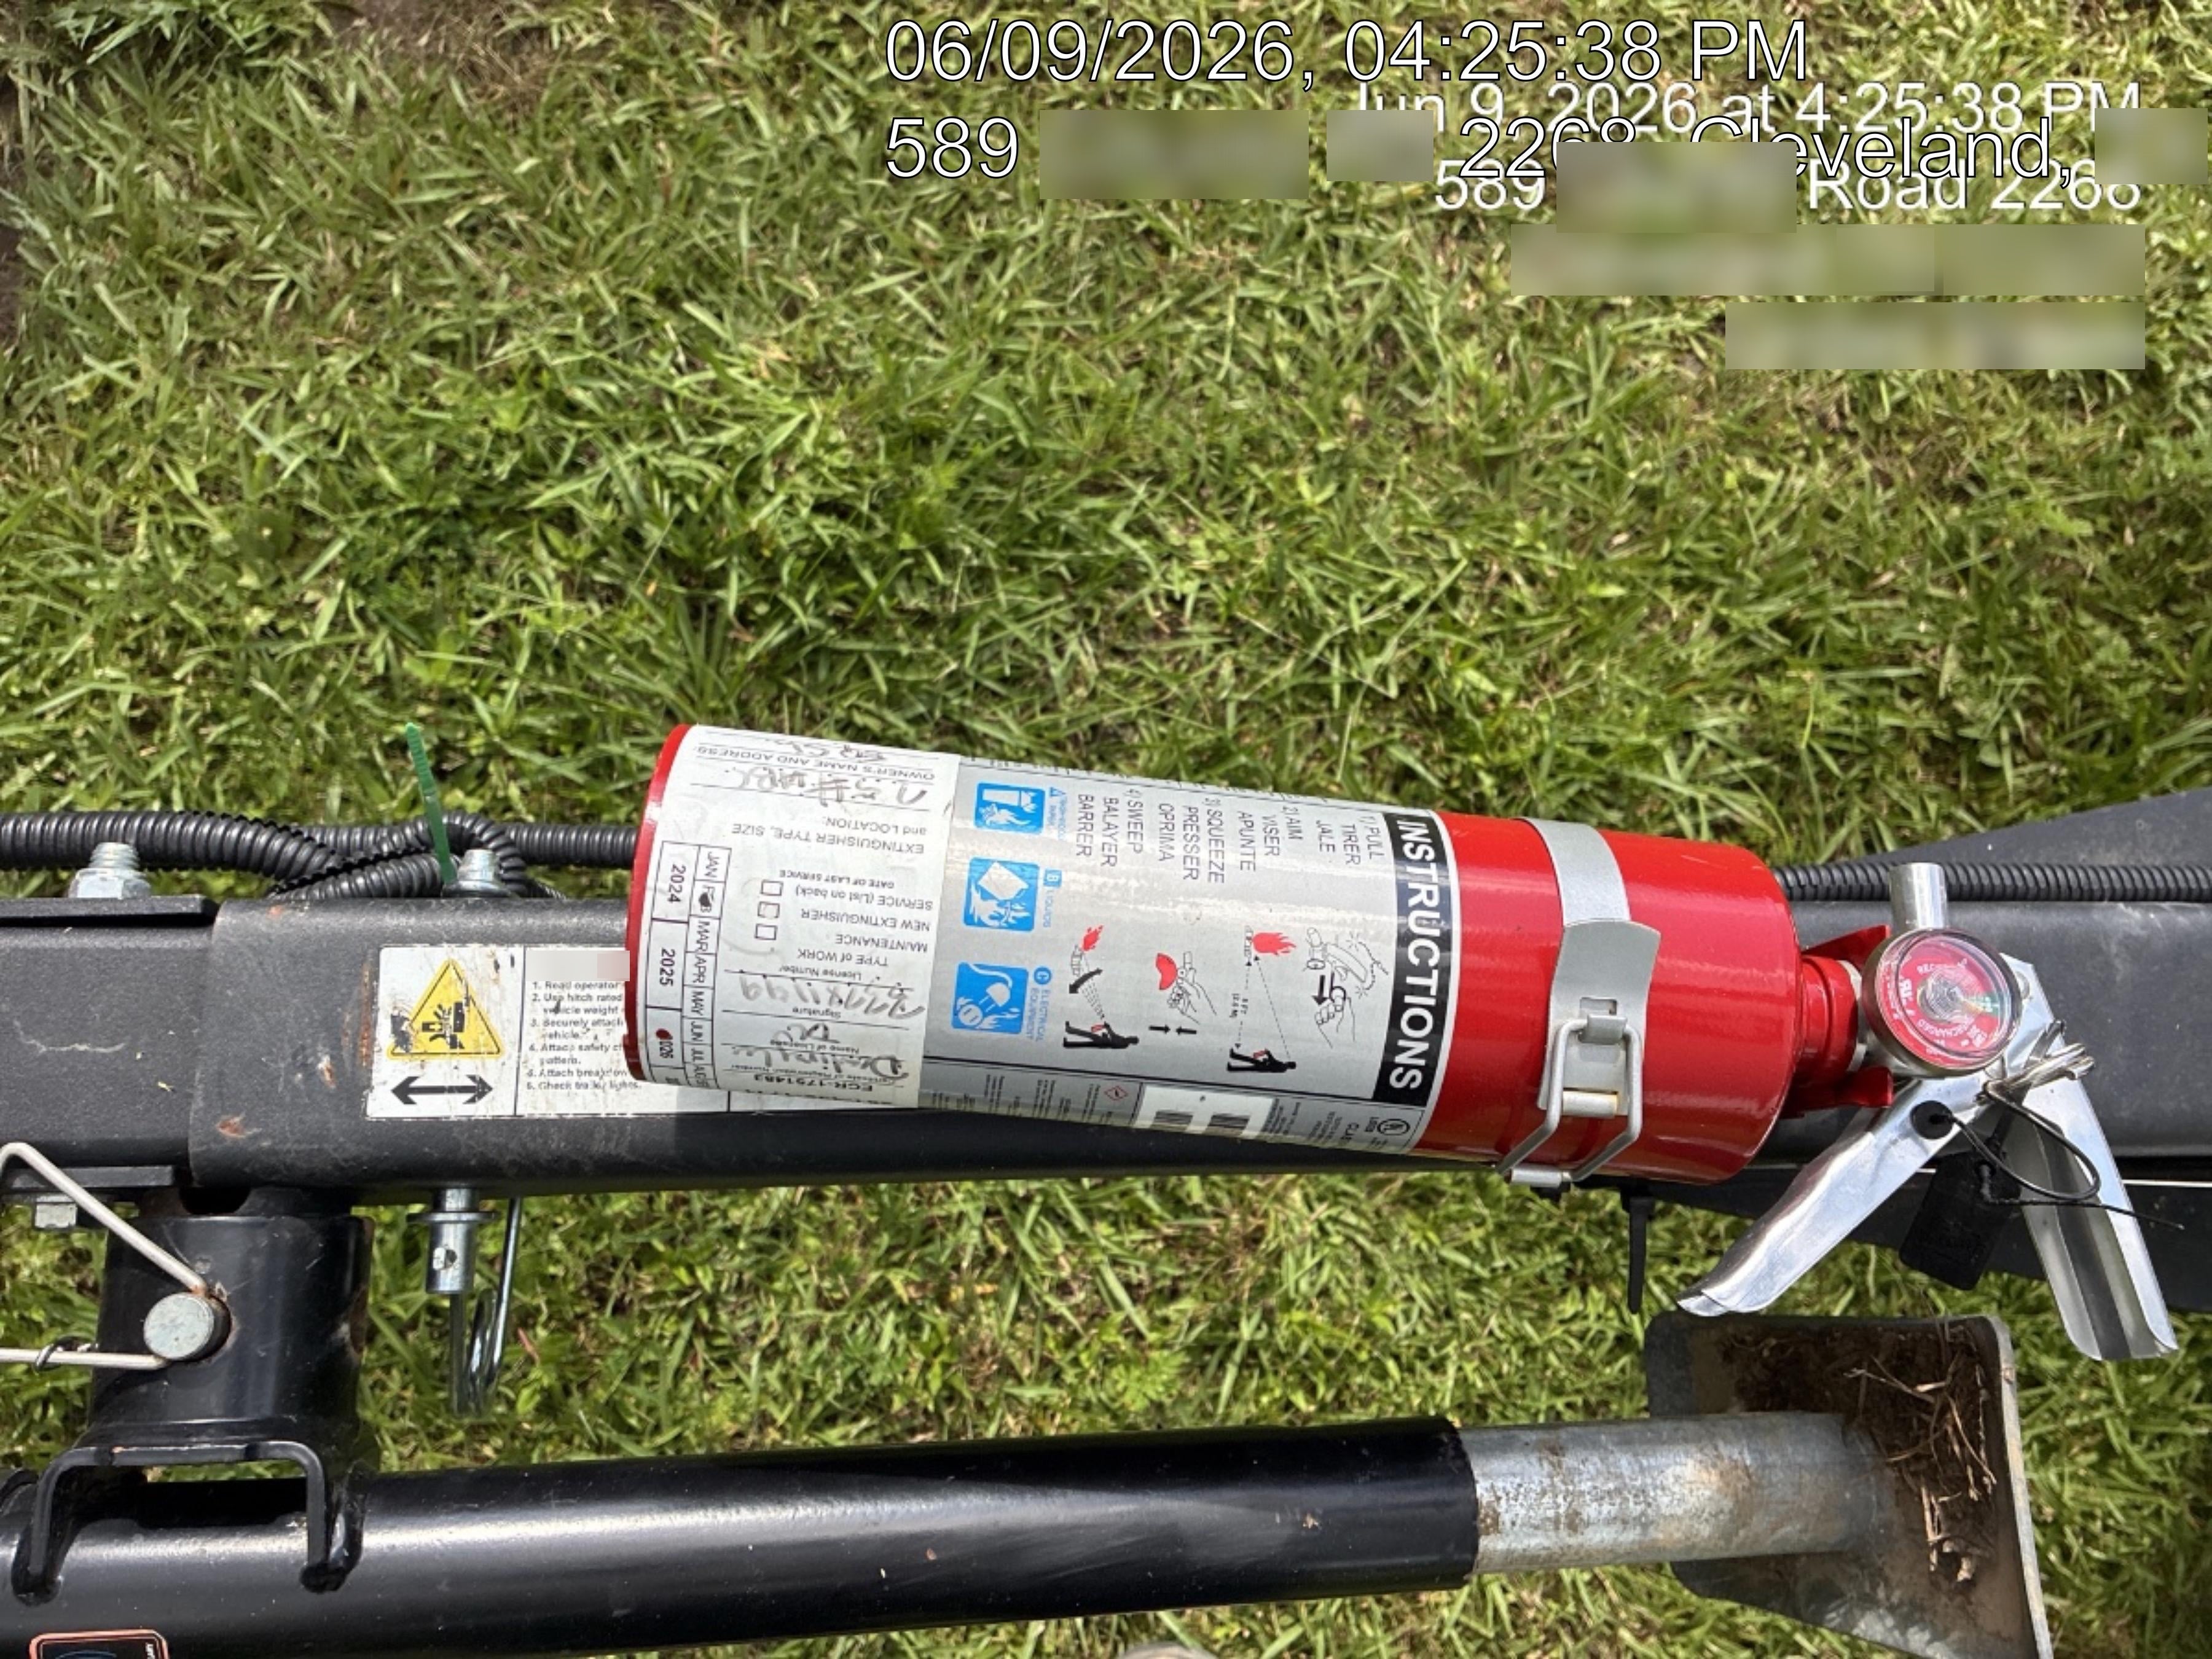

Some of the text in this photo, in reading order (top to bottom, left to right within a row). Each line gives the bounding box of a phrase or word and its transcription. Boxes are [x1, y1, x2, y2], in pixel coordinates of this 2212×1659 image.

[777, 755, 810, 766] AND
[814, 761, 858, 774] NAME
[862, 766, 935, 781] OWNER'S
[731, 823, 924, 855] EXTINGUISHER TYPE, SIZE
[821, 817, 927, 836] and LOCATION:
[1076, 794, 1094, 857] BARRER
[1101, 798, 1118, 867] BALAYER
[1127, 800, 1143, 853] SWEEP
[1158, 803, 1175, 861] OPRIMA
[1261, 815, 1280, 857] VISER
[1286, 817, 1303, 840] AIM
[1316, 820, 1335, 853] JALE
[1182, 806, 1199, 880] PRESSER
[1207, 809, 1225, 883] SQUEEZE
[1237, 810, 1256, 871] APUNTE
[1341, 824, 1360, 865] TIRER
[1367, 826, 1385, 860] PULL
[704, 852, 720, 877] JAN
[667, 864, 686, 903] 2024
[796, 885, 933, 911] SERVICE (List on back)
[801, 909, 930, 932] NEW EXTINGUISHER
[696, 920, 709, 952] MAR
[834, 934, 928, 952] MAINTENANCE
[659, 948, 675, 987] 2025
[797, 949, 888, 967] TYPE of WORK
[1389, 820, 1440, 1089] INSTRUCTIONS
[692, 955, 707, 983] APR
[778, 965, 861, 981] License Number
[690, 991, 705, 1016] MAY
[792, 1006, 841, 1019] Signature
[660, 1031, 674, 1058] 026
[691, 1021, 704, 1042] JUN
[692, 1047, 704, 1062] JUL
